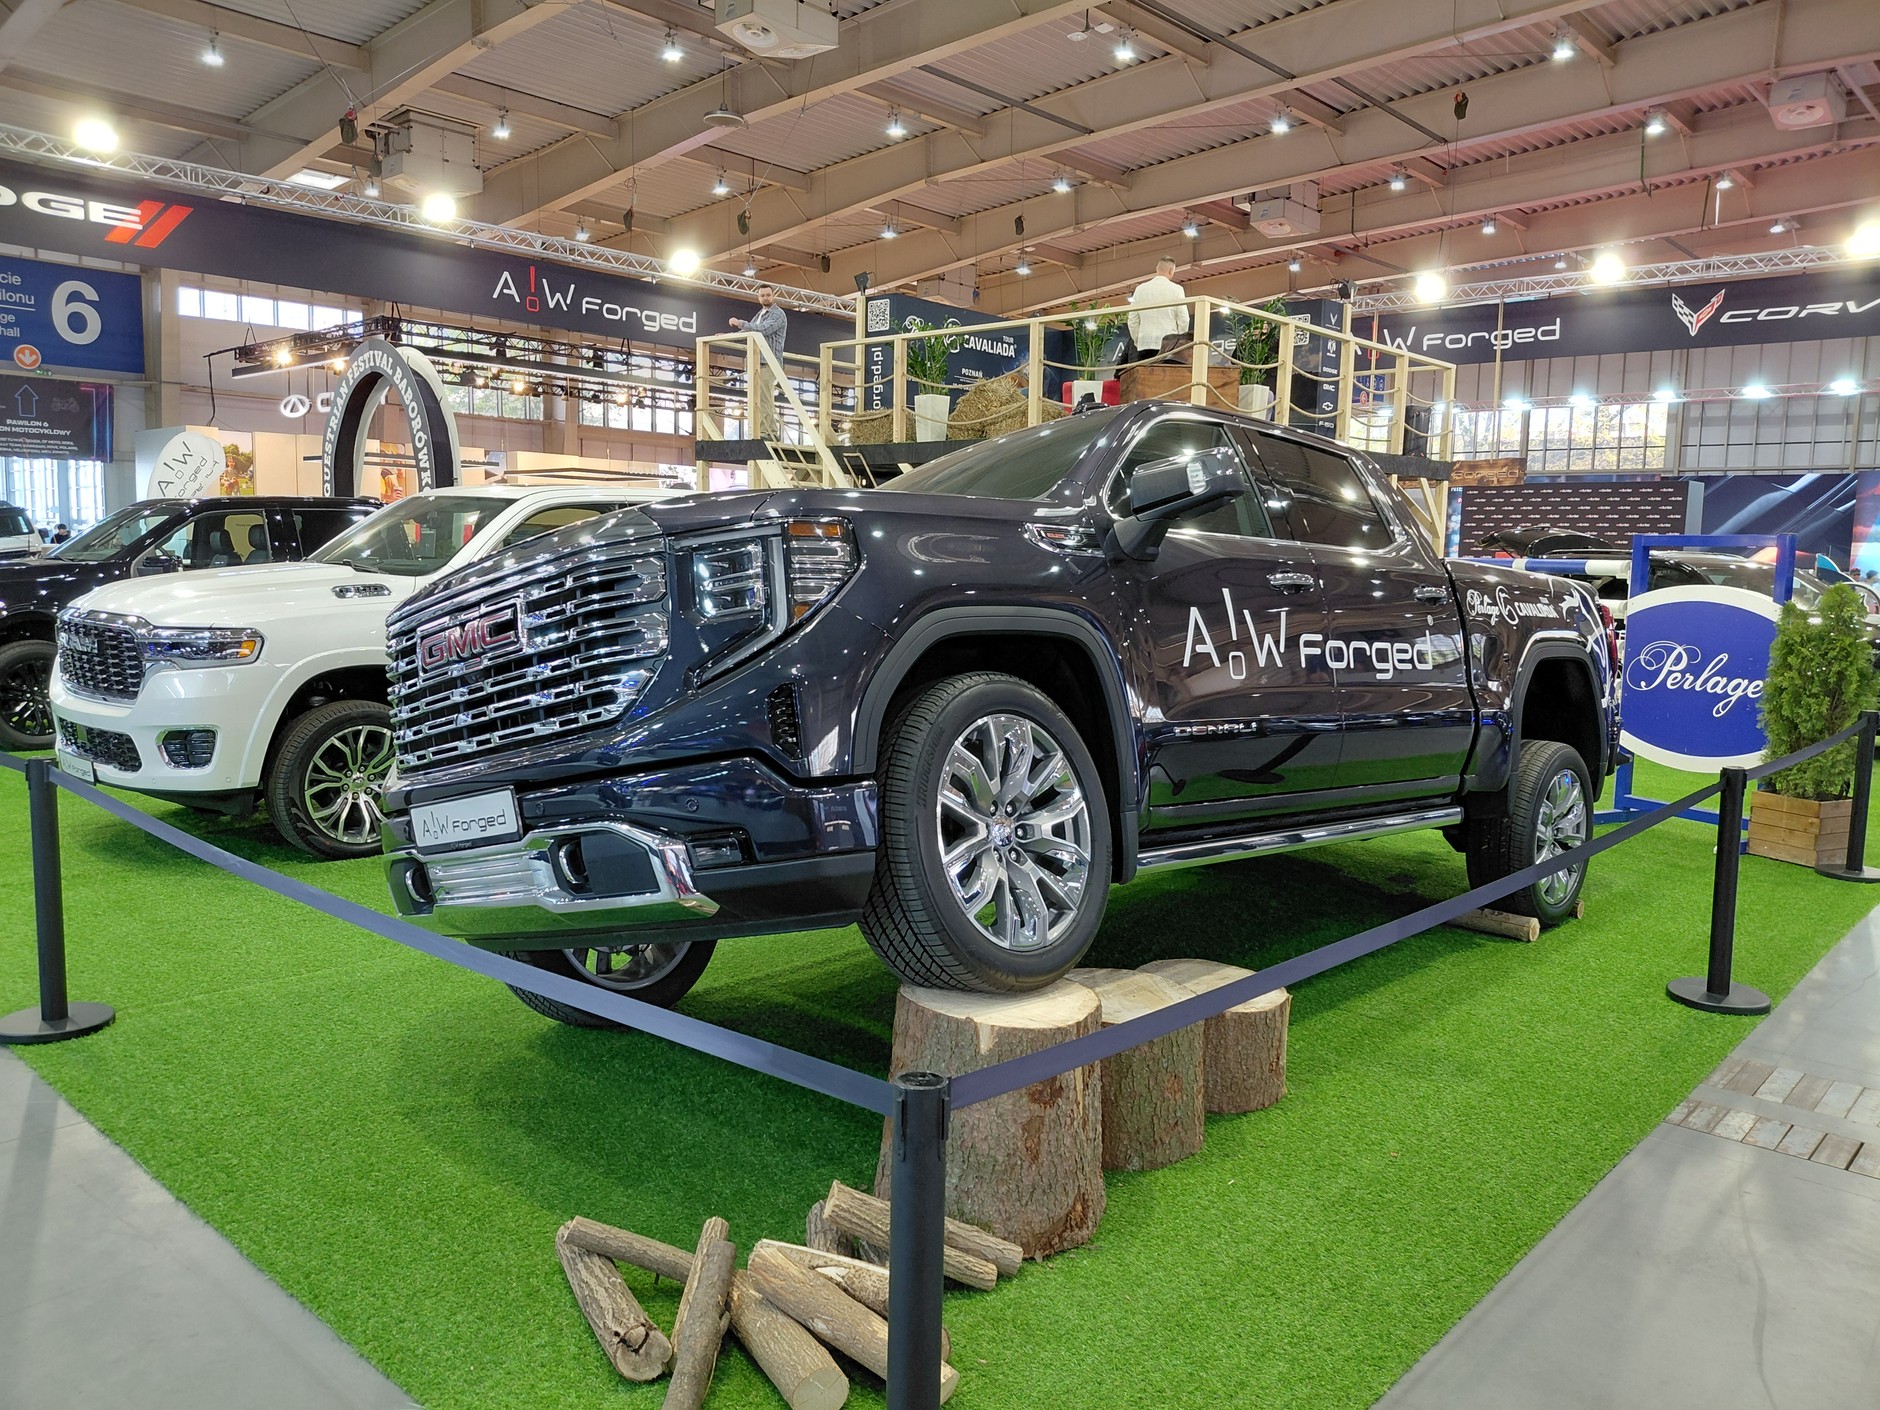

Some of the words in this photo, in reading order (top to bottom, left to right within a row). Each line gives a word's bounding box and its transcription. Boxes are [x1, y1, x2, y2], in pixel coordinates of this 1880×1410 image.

[51, 280, 102, 345] 6
[582, 298, 698, 334] Forged
[1422, 317, 1561, 351] Forged
[347, 349, 394, 386] FESTIVAL
[6, 419, 42, 427] PAWILON
[12, 427, 71, 436] MOTOCYKLOWY
[420, 608, 515, 671] GMC
[1626, 640, 1765, 718] Perlage
[1172, 722, 1258, 737] DENALI
[451, 808, 507, 833] Forged
